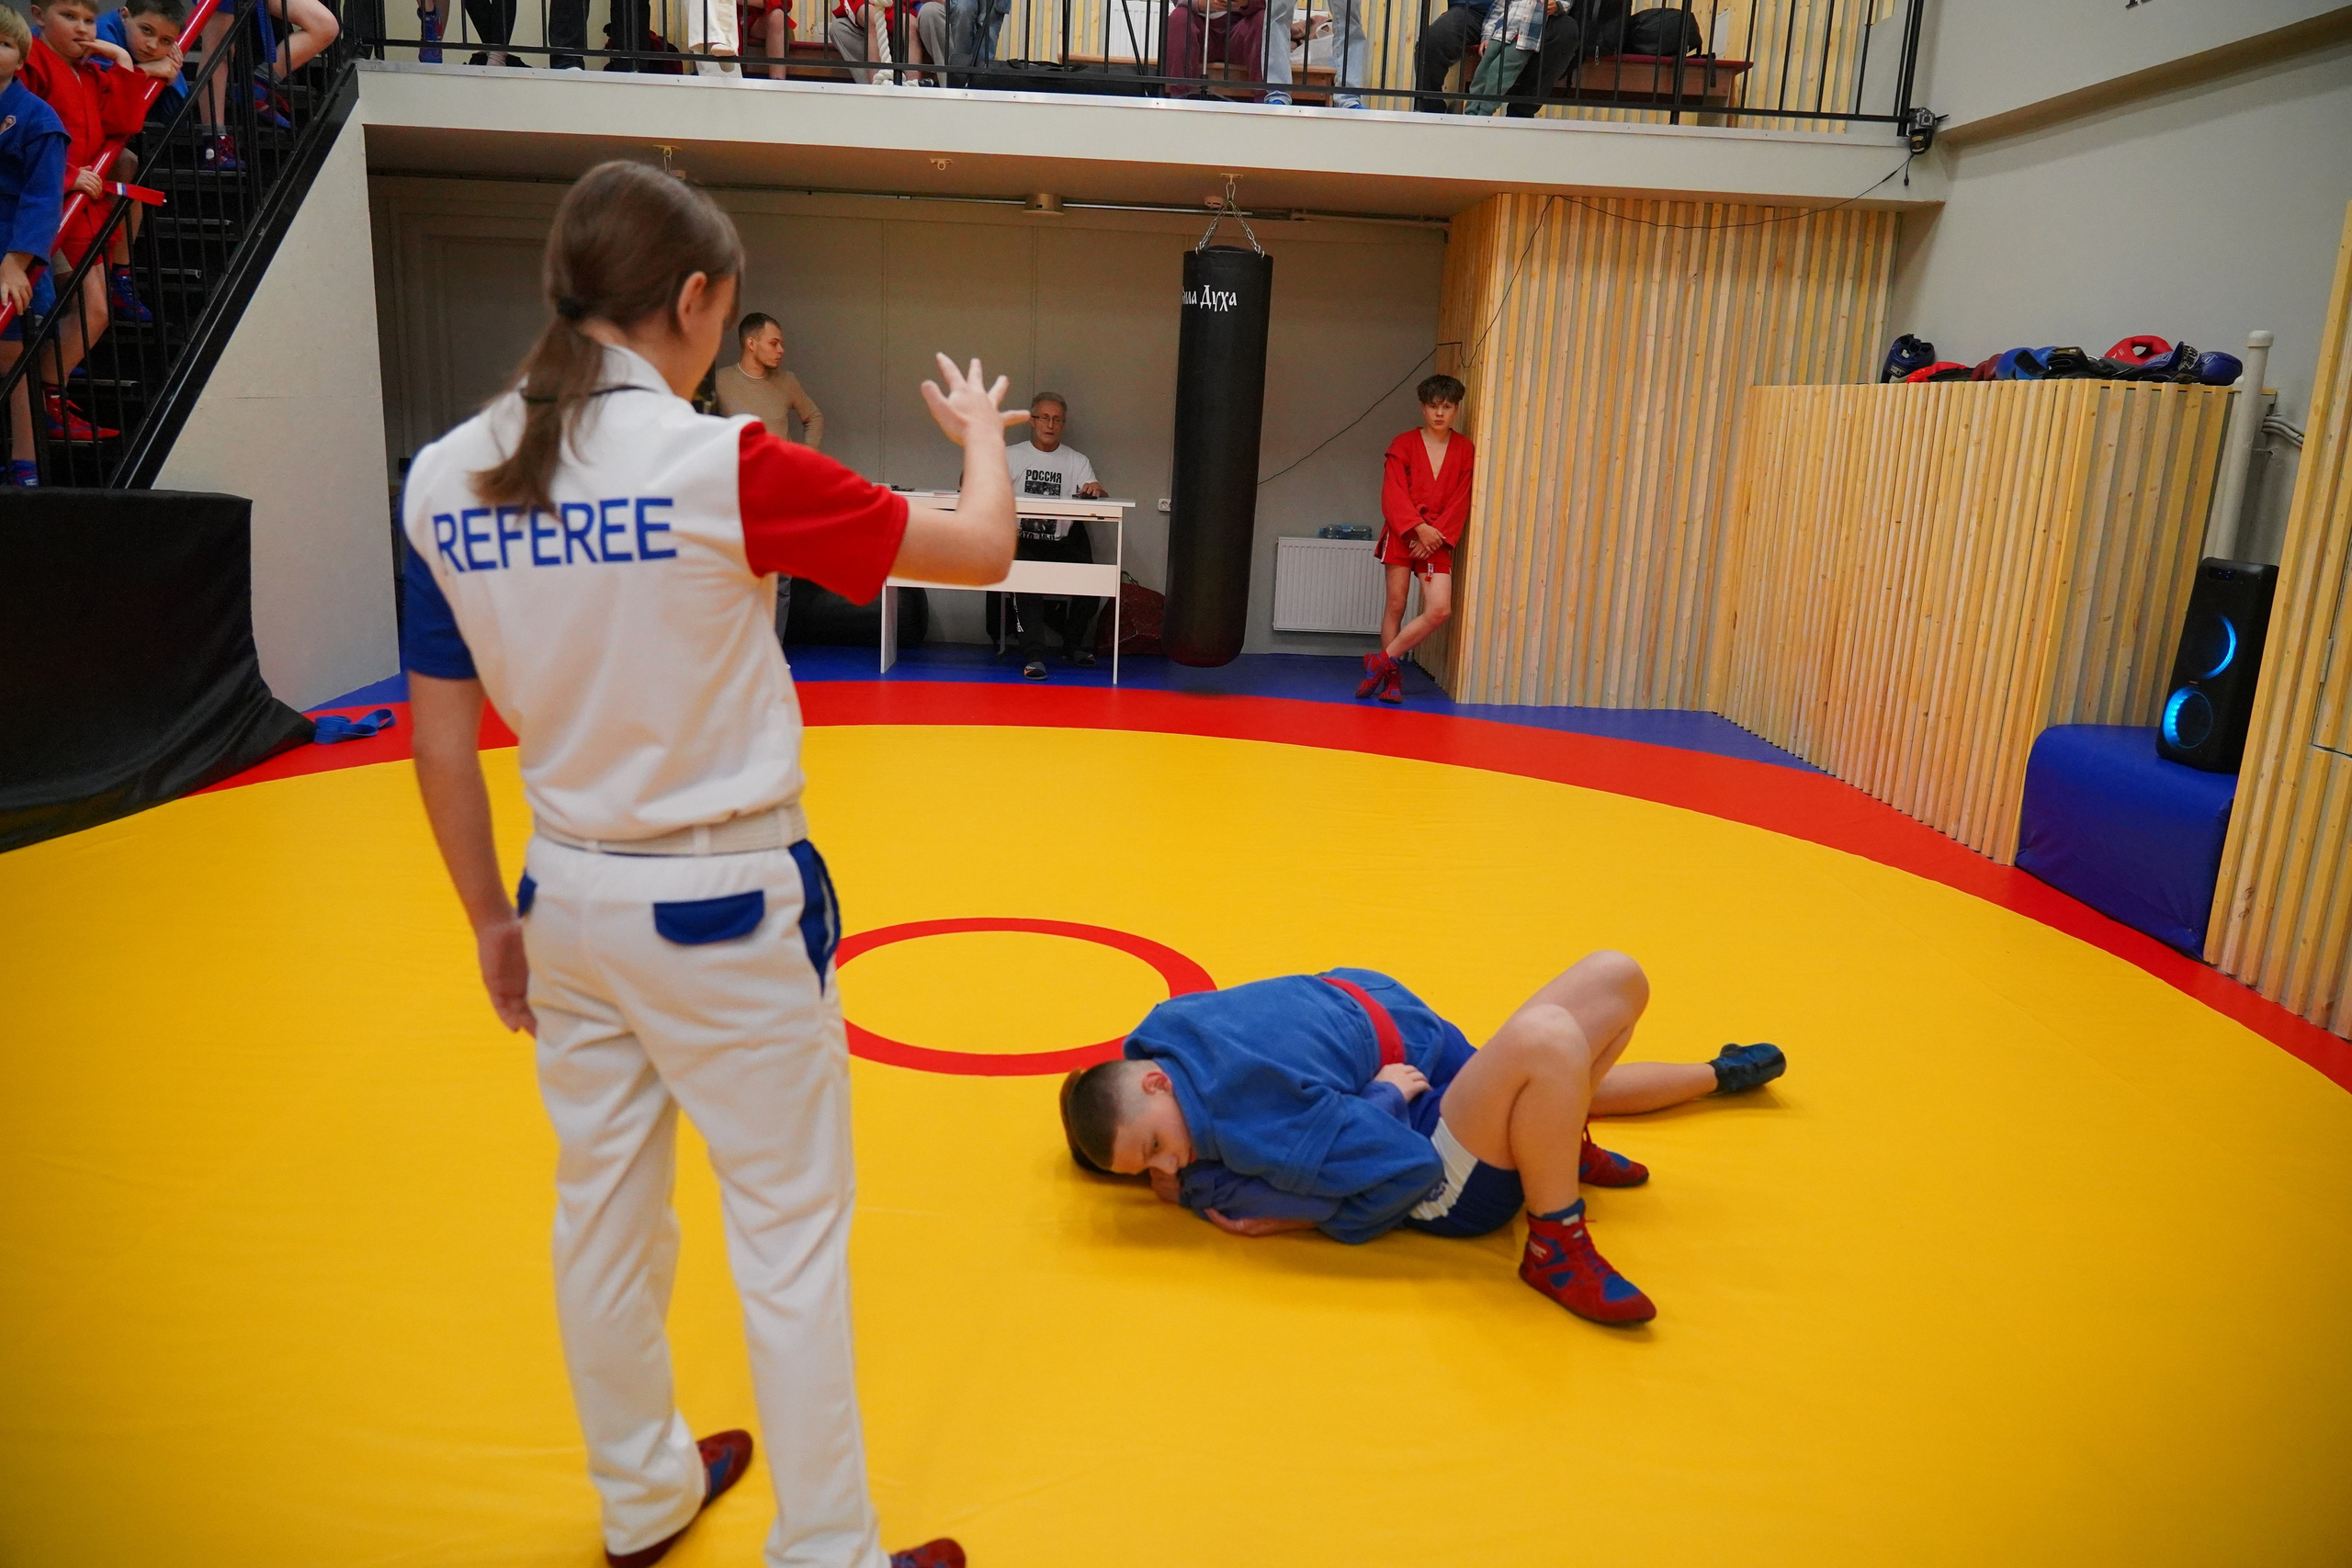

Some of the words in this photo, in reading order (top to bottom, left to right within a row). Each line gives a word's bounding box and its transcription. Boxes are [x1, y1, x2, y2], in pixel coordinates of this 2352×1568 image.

[1200, 285, 1238, 311] Духа
[1025, 469, 1062, 484] РОССИЯ
[433, 498, 677, 573] REFEREE
